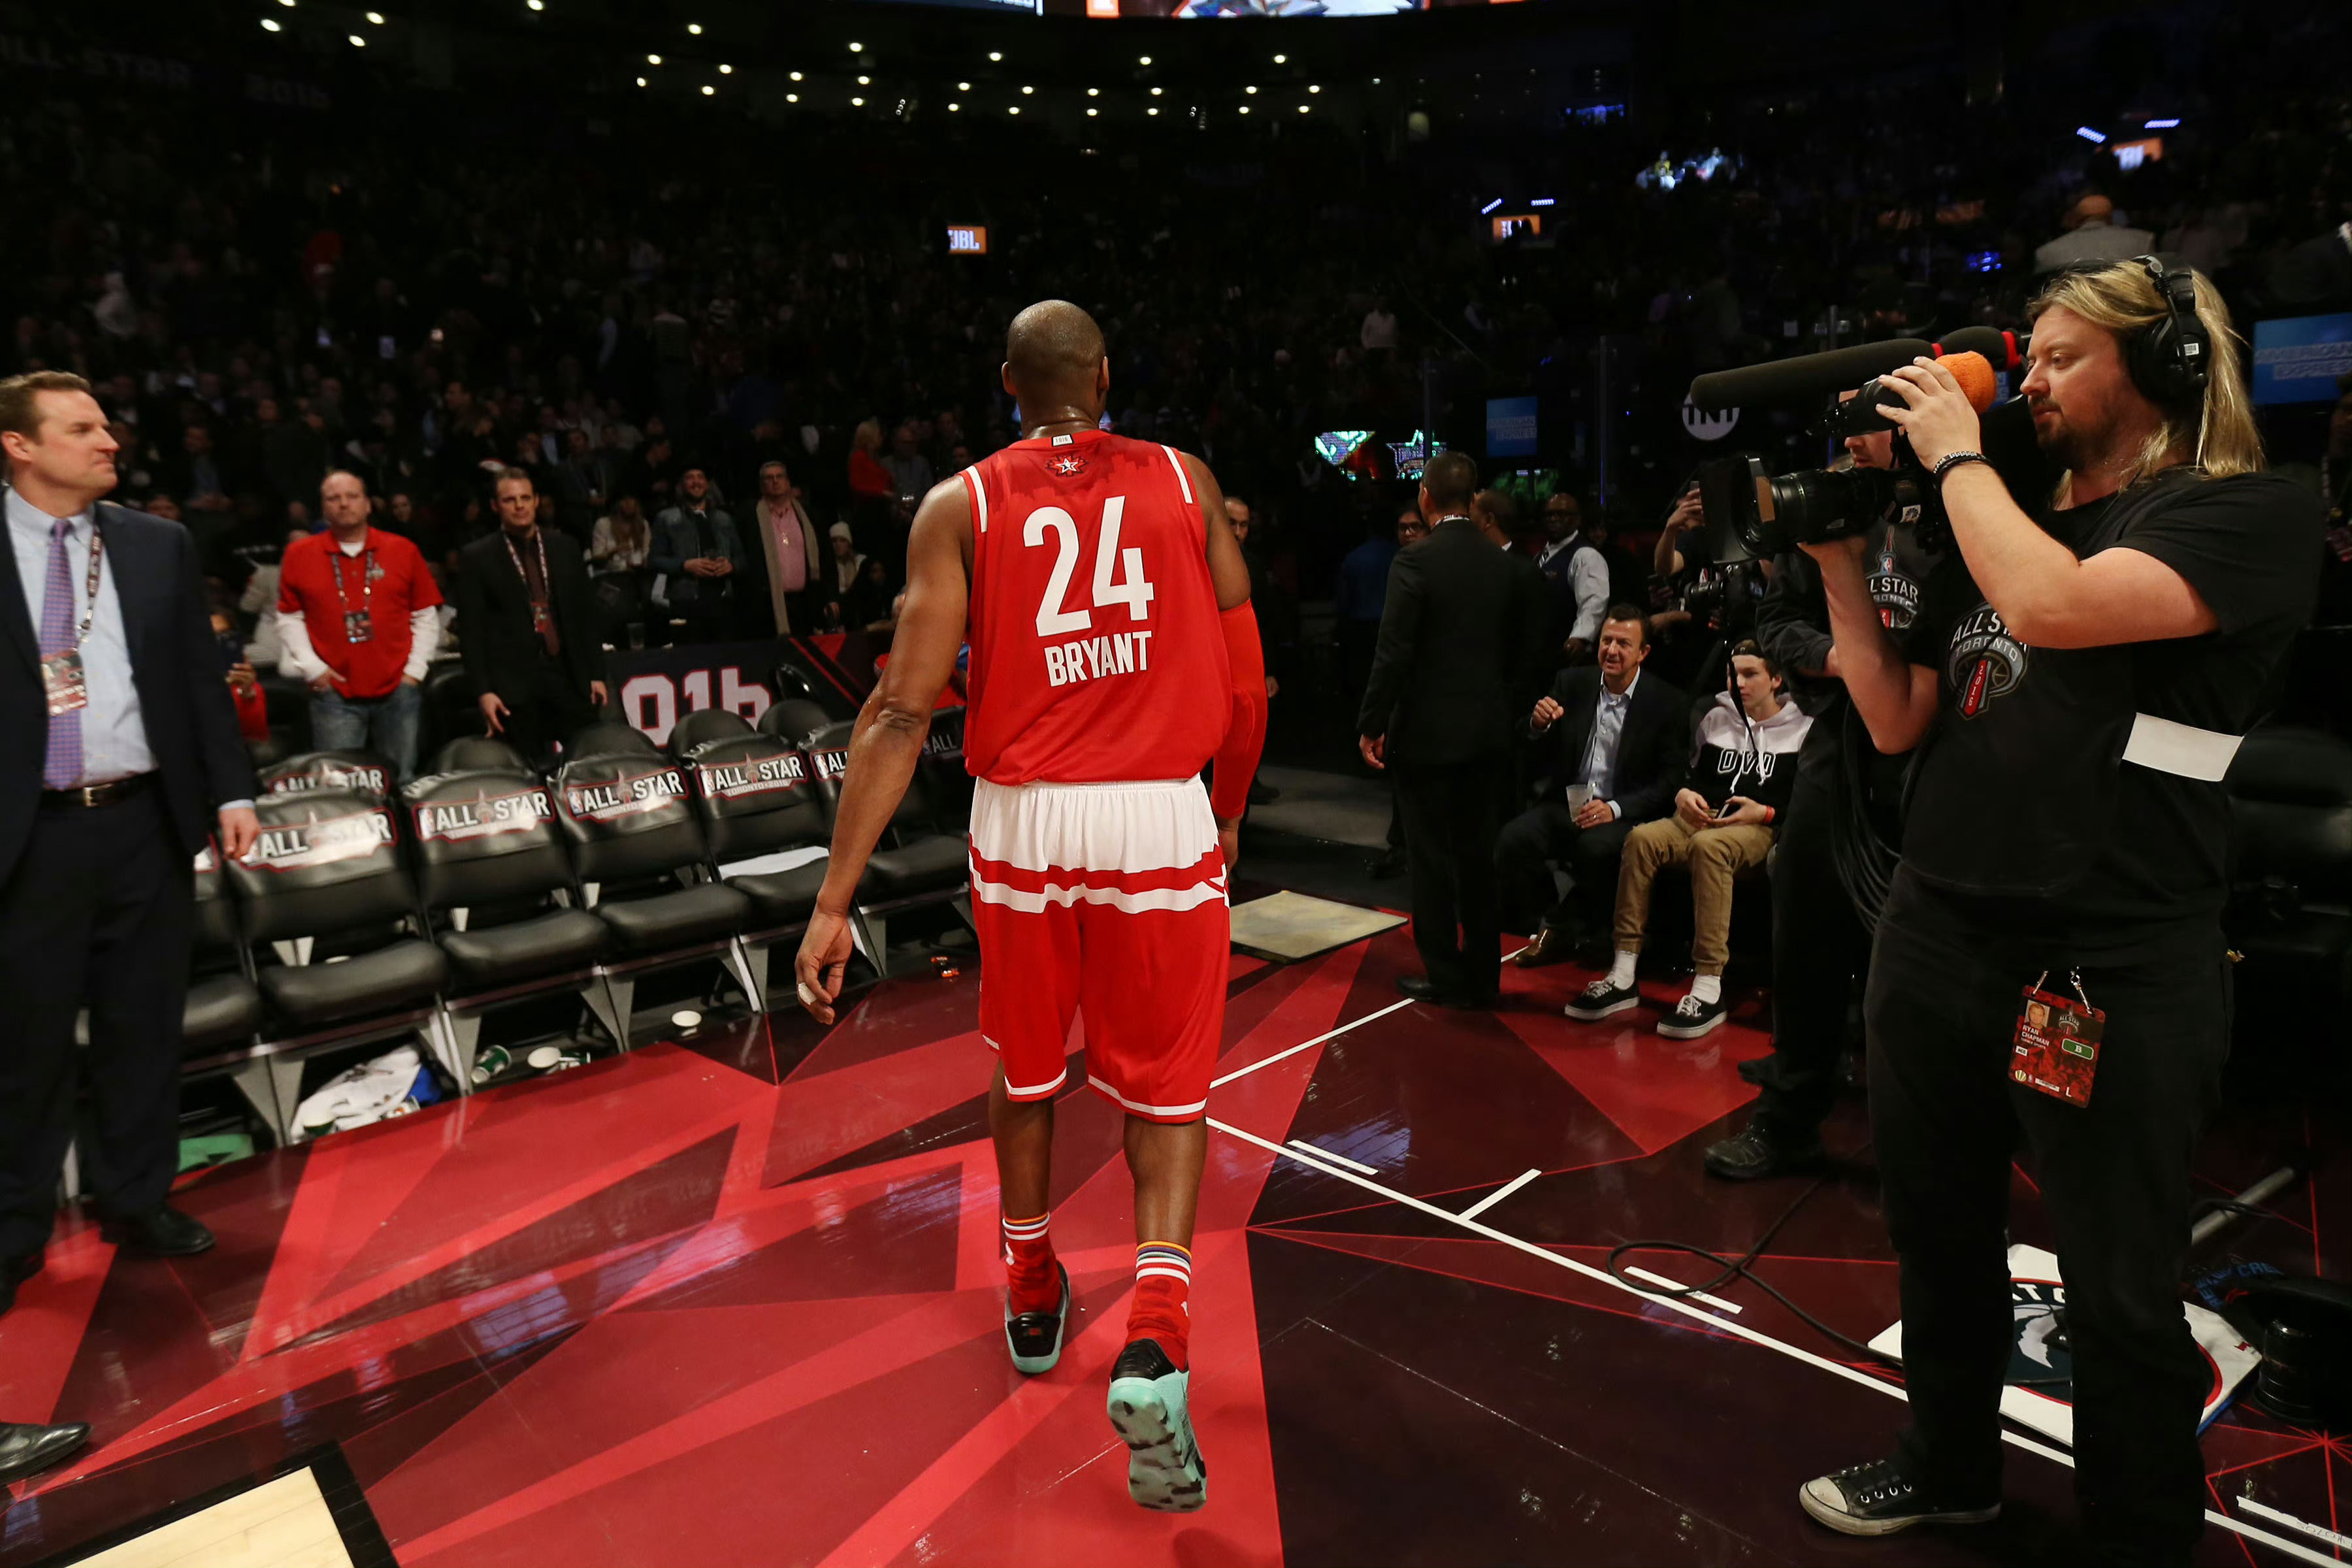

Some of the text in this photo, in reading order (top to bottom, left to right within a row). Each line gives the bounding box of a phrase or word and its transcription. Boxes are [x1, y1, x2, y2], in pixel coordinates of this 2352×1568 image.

[947, 230, 980, 250] JBL
[1023, 495, 1155, 638] 24
[1882, 577, 1918, 604] STAR
[1950, 613, 1984, 651] ALL
[1044, 630, 1152, 687] BRYANT
[621, 666, 774, 747] 016
[931, 734, 957, 753] ALL
[715, 756, 804, 790] ALL STAR
[1717, 748, 1776, 778] OVO
[583, 787, 619, 812] ALL
[632, 772, 683, 799] STAR
[436, 806, 478, 831] ALL
[495, 792, 550, 820] STAR
[259, 830, 308, 858] ALL
[2021, 1031, 2050, 1046] CHAPMAN
[2022, 1024, 2039, 1036] RYAN
[2074, 1045, 2082, 1053] B
[2065, 1086, 2072, 1098] L
